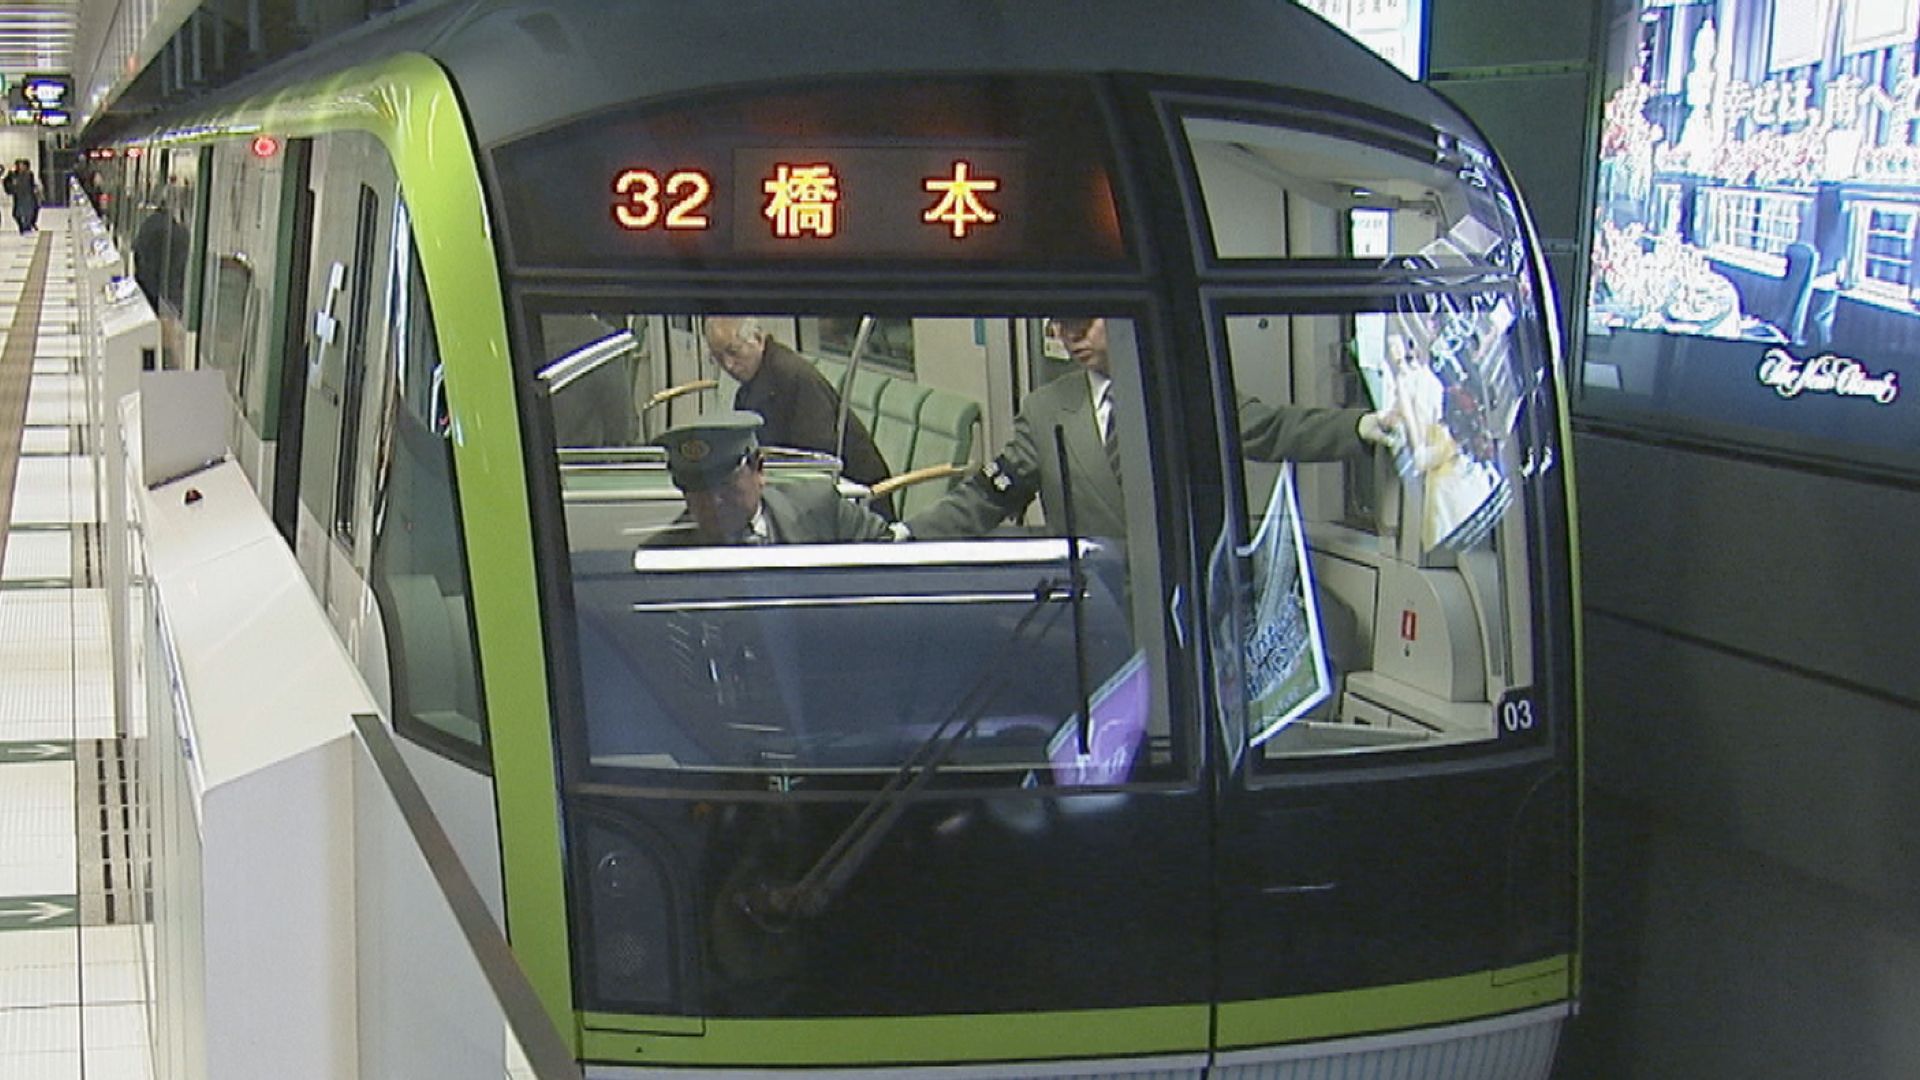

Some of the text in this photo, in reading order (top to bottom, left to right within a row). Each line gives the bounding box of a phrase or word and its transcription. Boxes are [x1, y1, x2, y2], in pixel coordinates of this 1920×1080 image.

[613, 169, 711, 230] 32
[763, 161, 998, 238] 橋本
[1503, 699, 1533, 731] 03
